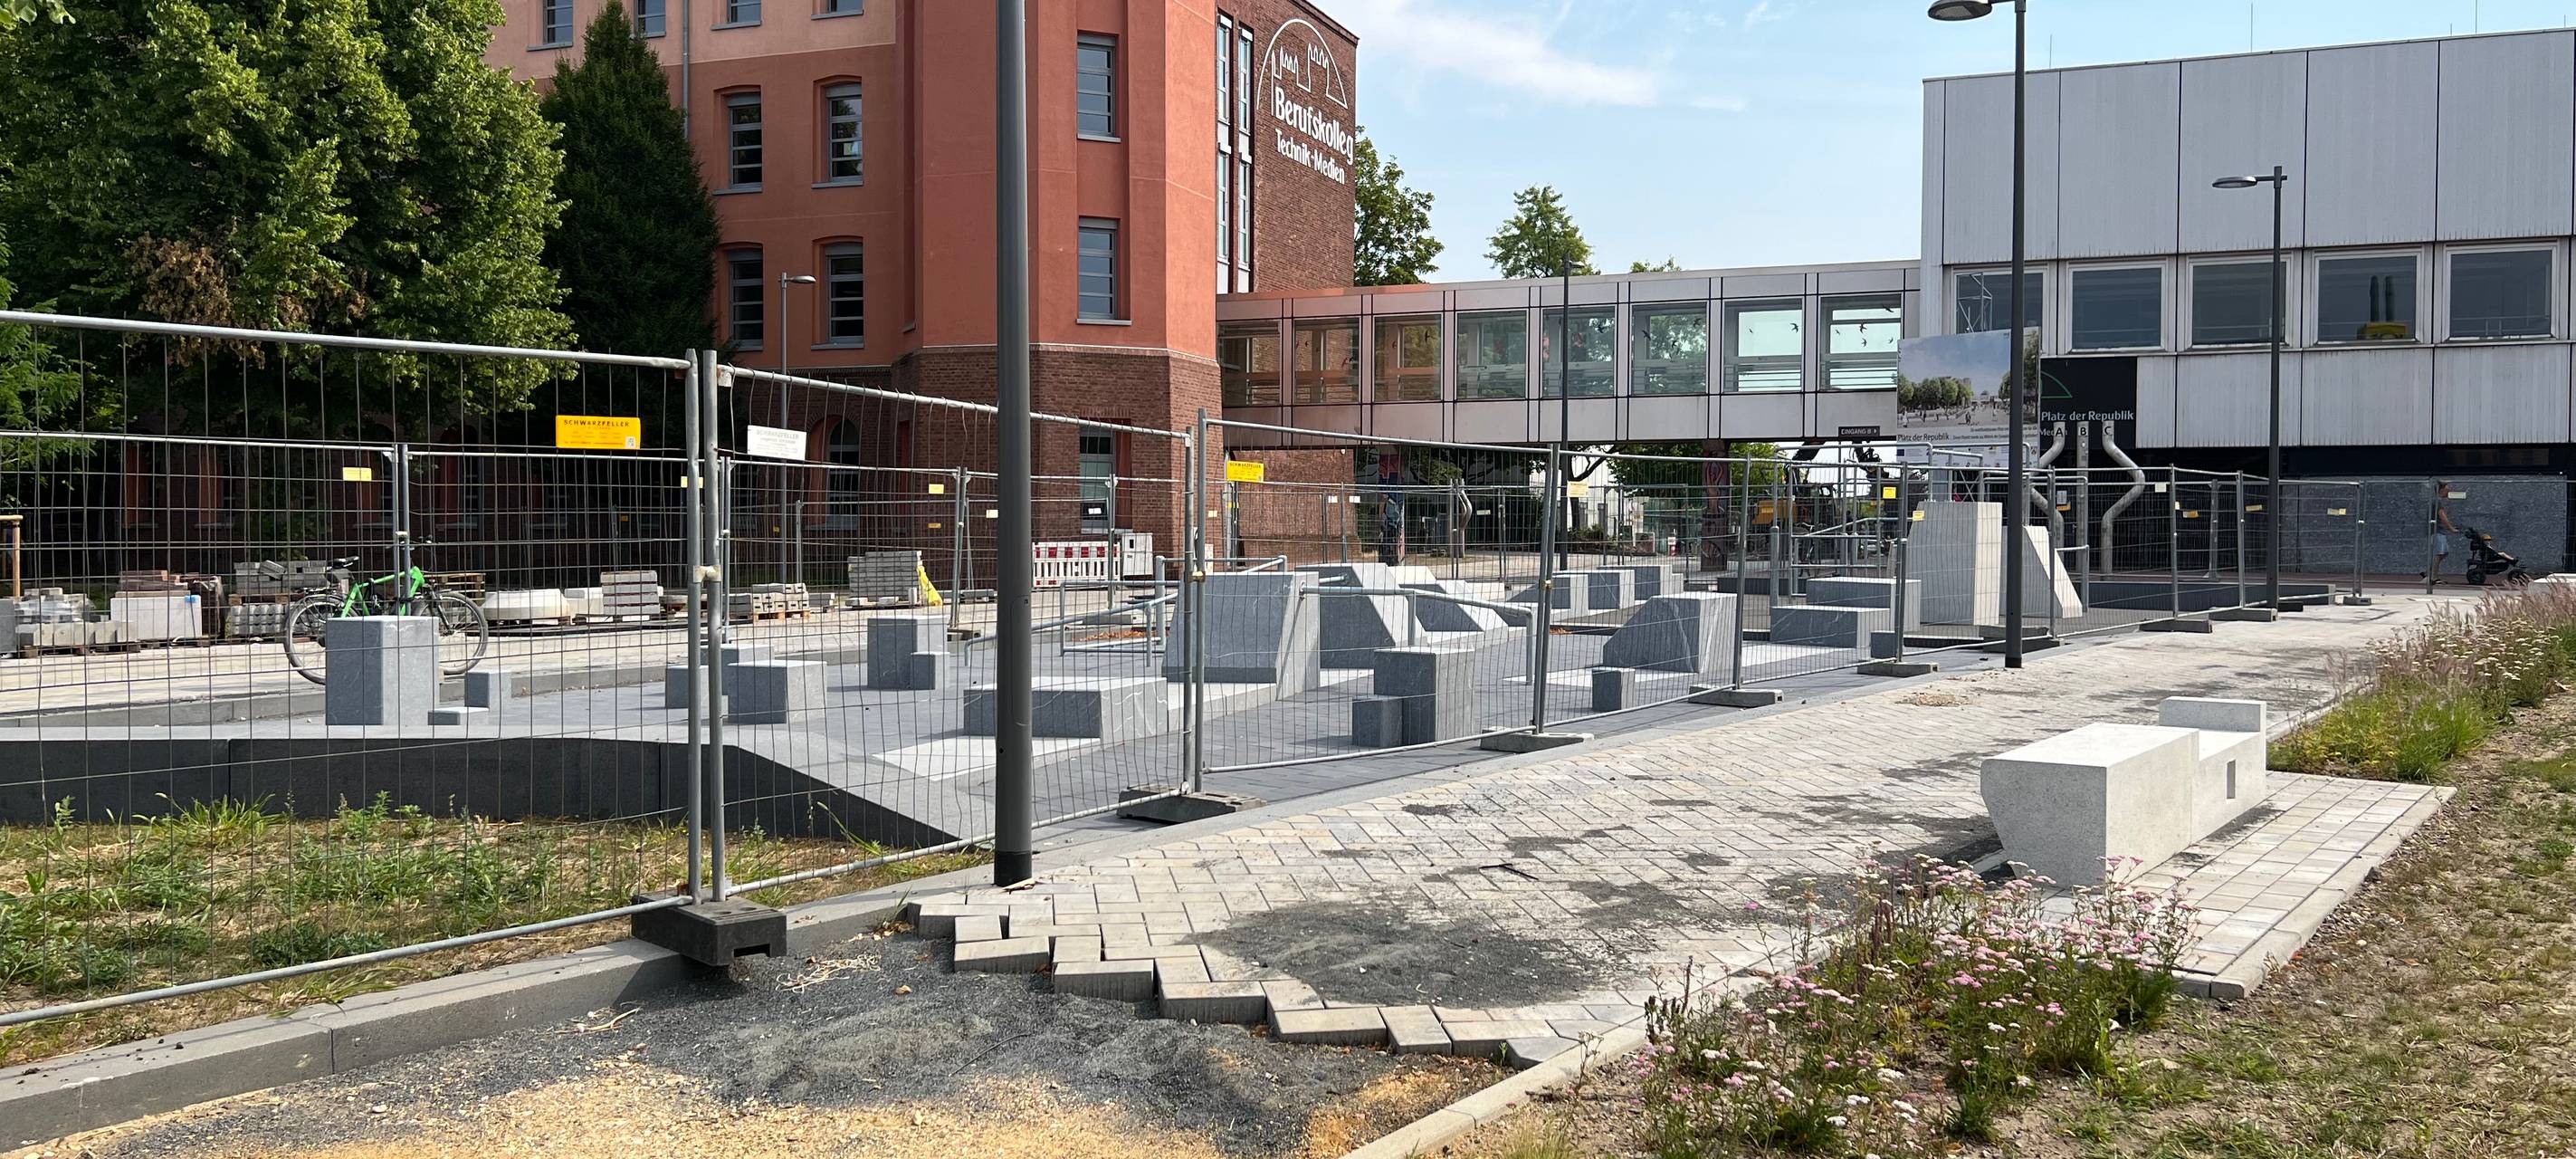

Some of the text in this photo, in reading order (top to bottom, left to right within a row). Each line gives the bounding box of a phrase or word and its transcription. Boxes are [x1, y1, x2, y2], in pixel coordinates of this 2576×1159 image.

[1275, 86, 1354, 166] Berufskolleg
[2041, 410, 2134, 423] Platz der Republik
[563, 419, 630, 427] SCHWARZFELLER
[2039, 428, 2068, 436] Medn
[2055, 426, 2064, 436] A
[2080, 426, 2087, 436] B
[2104, 426, 2113, 436] C
[1913, 433, 1922, 441] der
[1923, 432, 1950, 442] Republik
